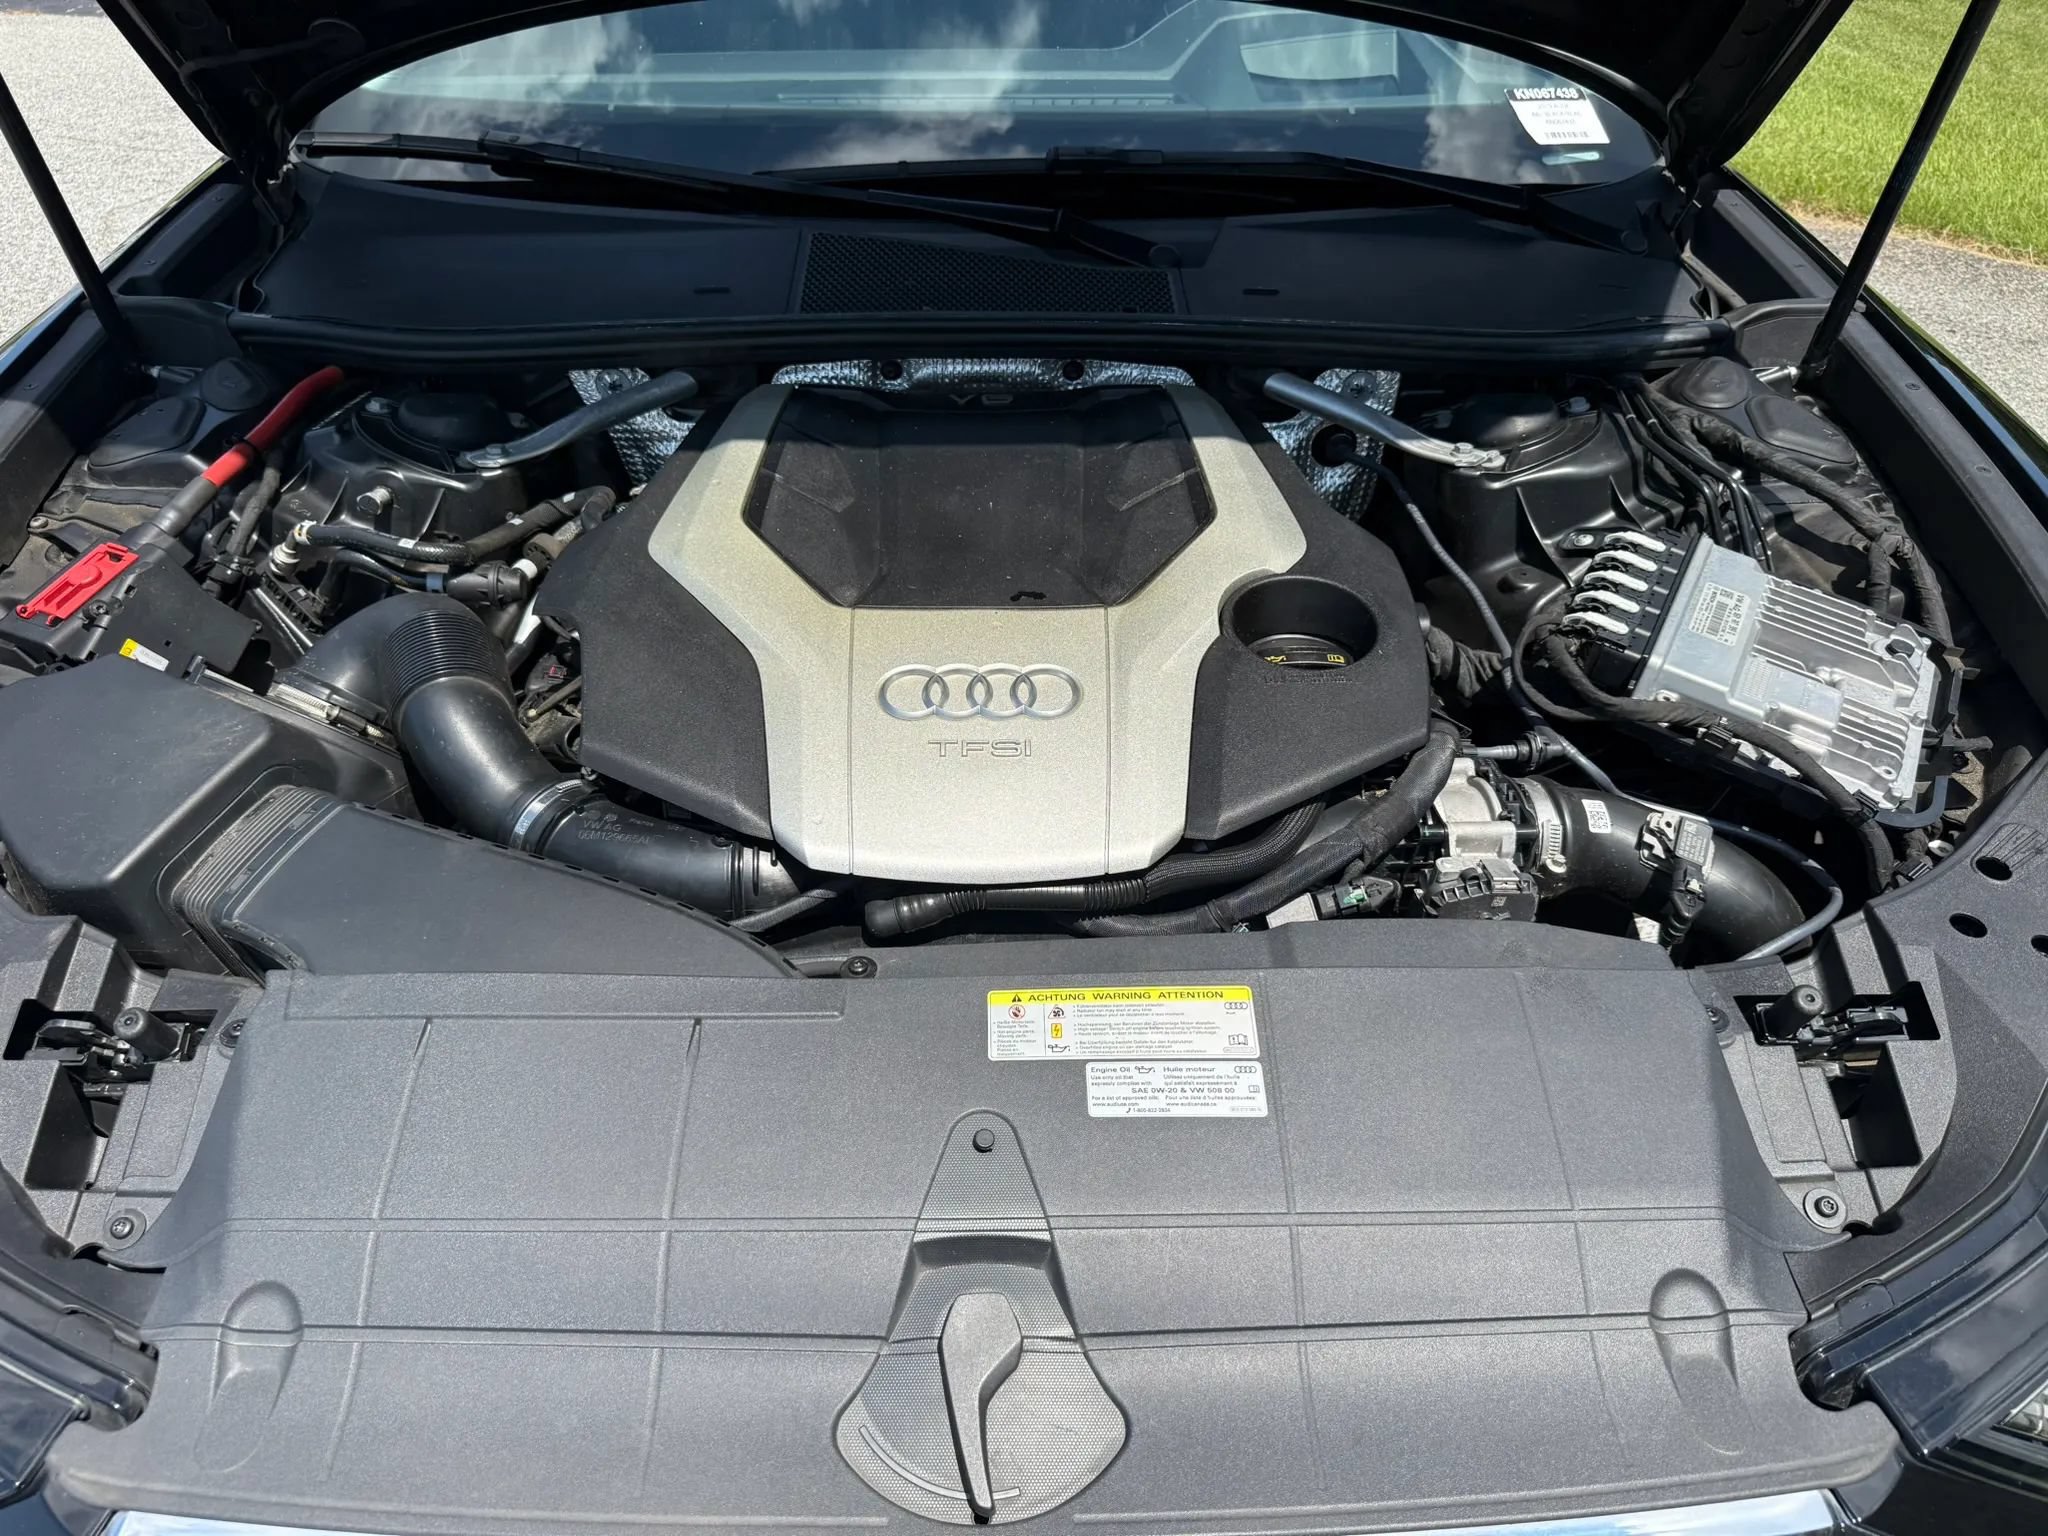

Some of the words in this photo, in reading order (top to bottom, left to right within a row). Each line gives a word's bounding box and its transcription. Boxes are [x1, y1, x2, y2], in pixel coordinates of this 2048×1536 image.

[1513, 87, 1579, 100] KN067438
[928, 739, 1032, 757] TFSI
[1028, 993, 1086, 1002] ACHTUNG
[1092, 991, 1151, 1000] WARNING
[1158, 990, 1224, 1000] ATTENTION
